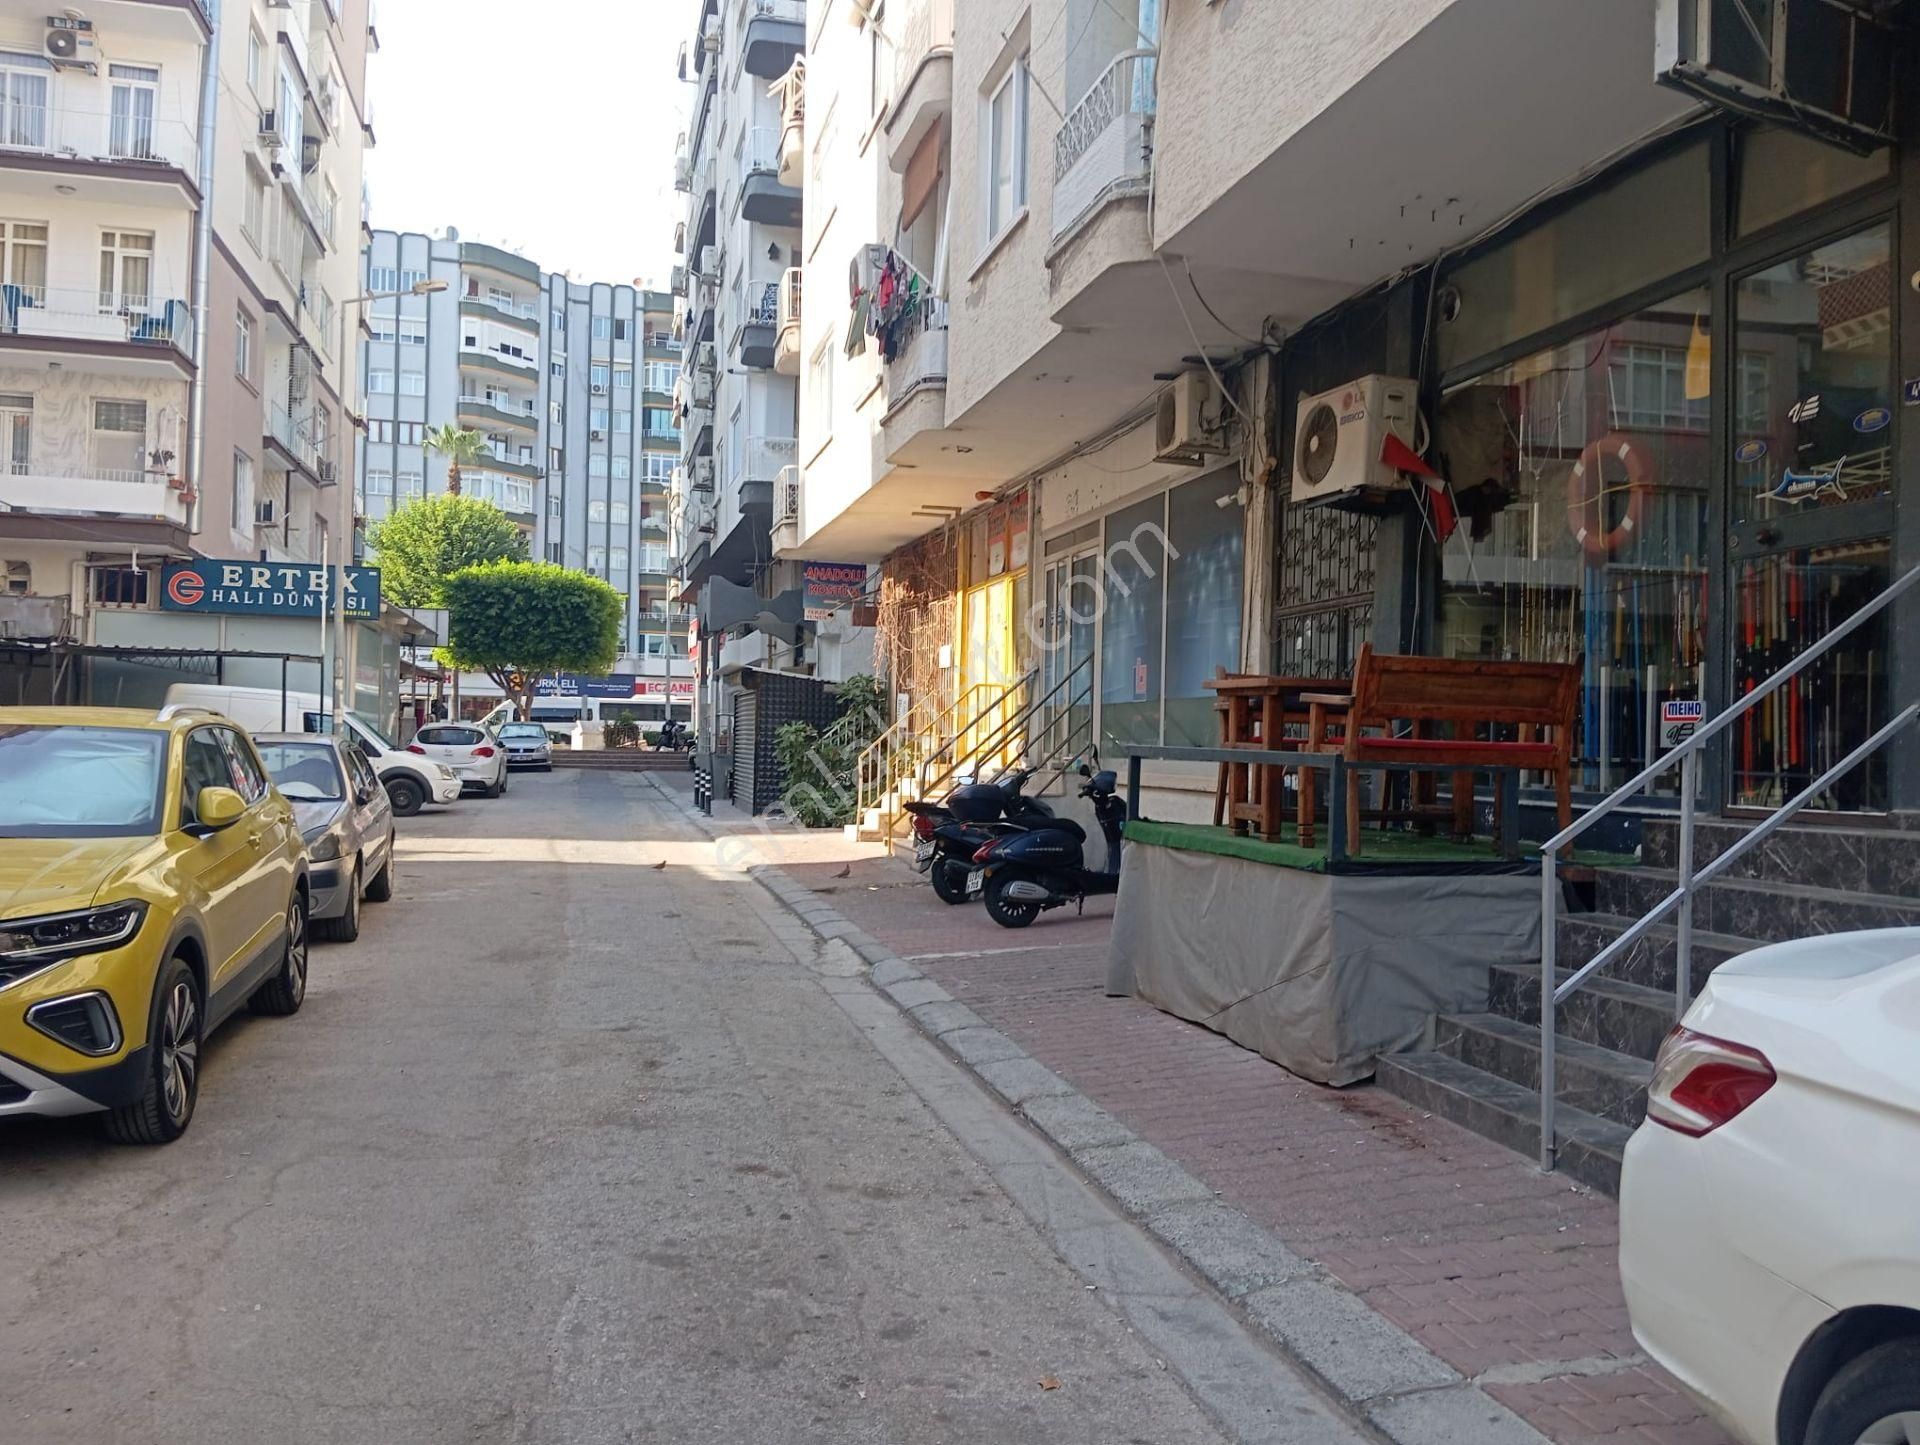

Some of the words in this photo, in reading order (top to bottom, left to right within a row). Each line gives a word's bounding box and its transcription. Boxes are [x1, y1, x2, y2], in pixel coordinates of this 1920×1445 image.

[806, 567, 866, 581] ANADOLU
[212, 590, 263, 604] HALI
[1668, 702, 1701, 716] MEIHO
